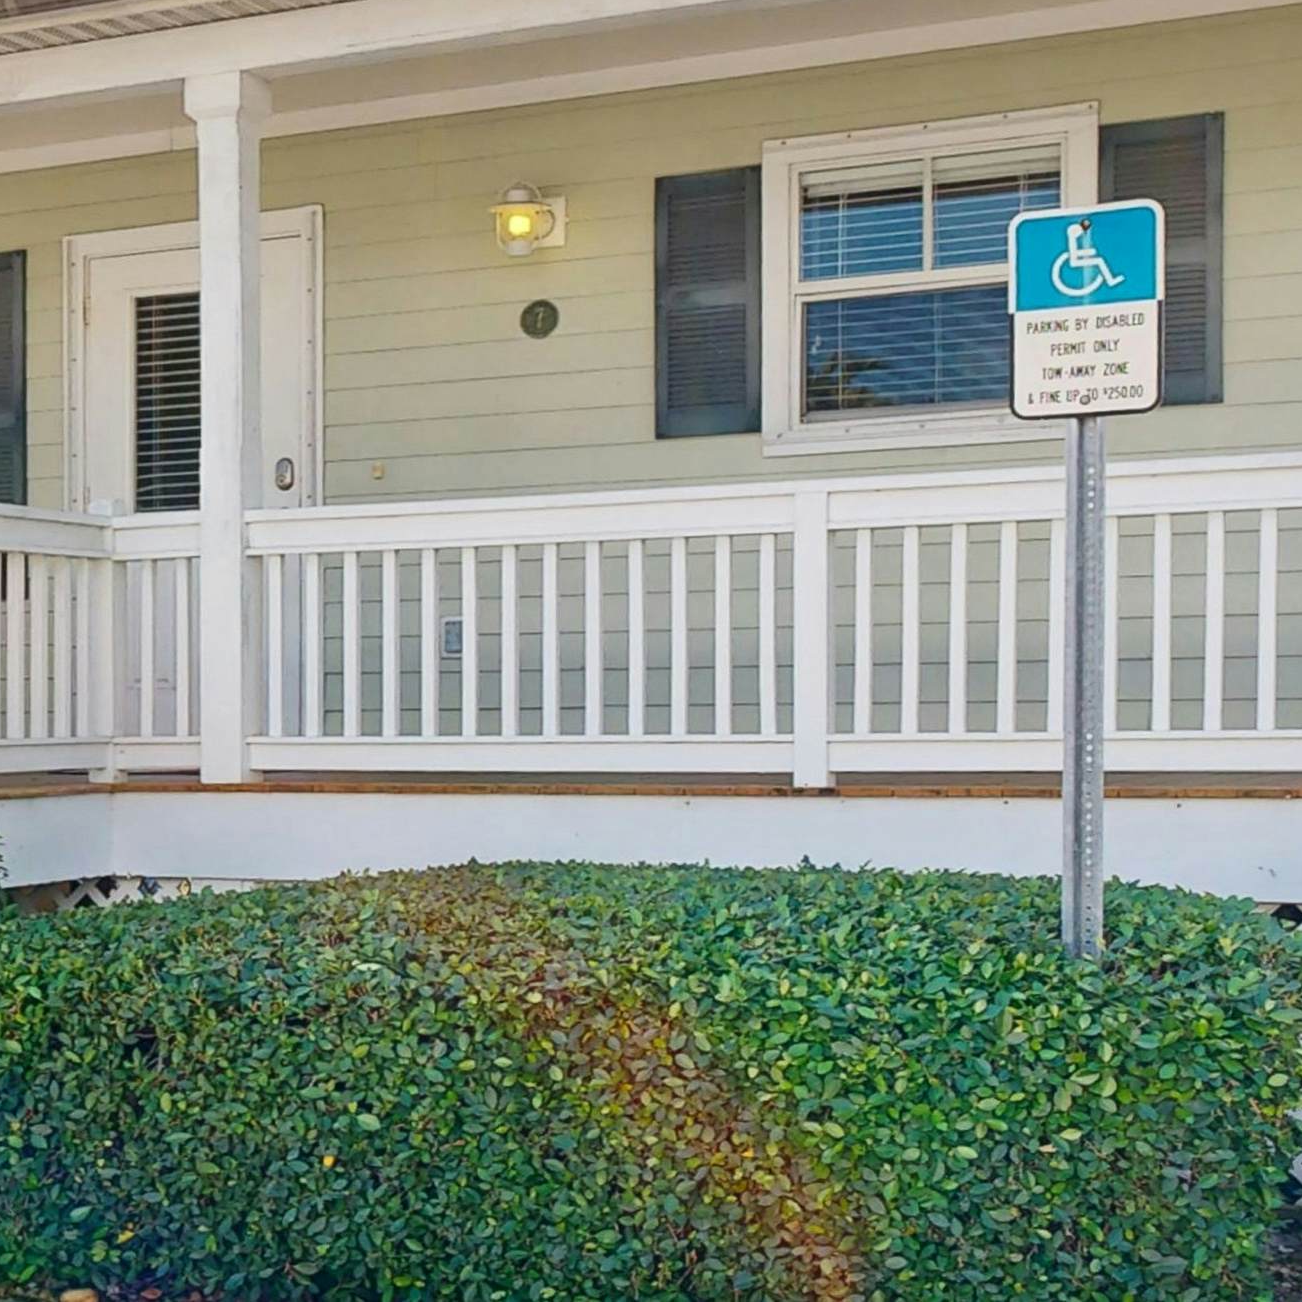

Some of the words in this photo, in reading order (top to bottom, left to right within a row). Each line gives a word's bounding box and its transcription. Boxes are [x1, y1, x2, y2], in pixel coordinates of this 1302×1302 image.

[1026, 319, 1069, 334] PARKING
[1075, 317, 1089, 332] BY
[1096, 312, 1145, 328] DISABLED
[1050, 341, 1087, 357] PERMIT
[1093, 338, 1120, 353] ONLY
[1103, 362, 1129, 376] ZONE
[1028, 393, 1034, 404] &
[1039, 390, 1062, 404] FINE
[1066, 389, 1080, 403] UP
[1086, 387, 1098, 401] TO
